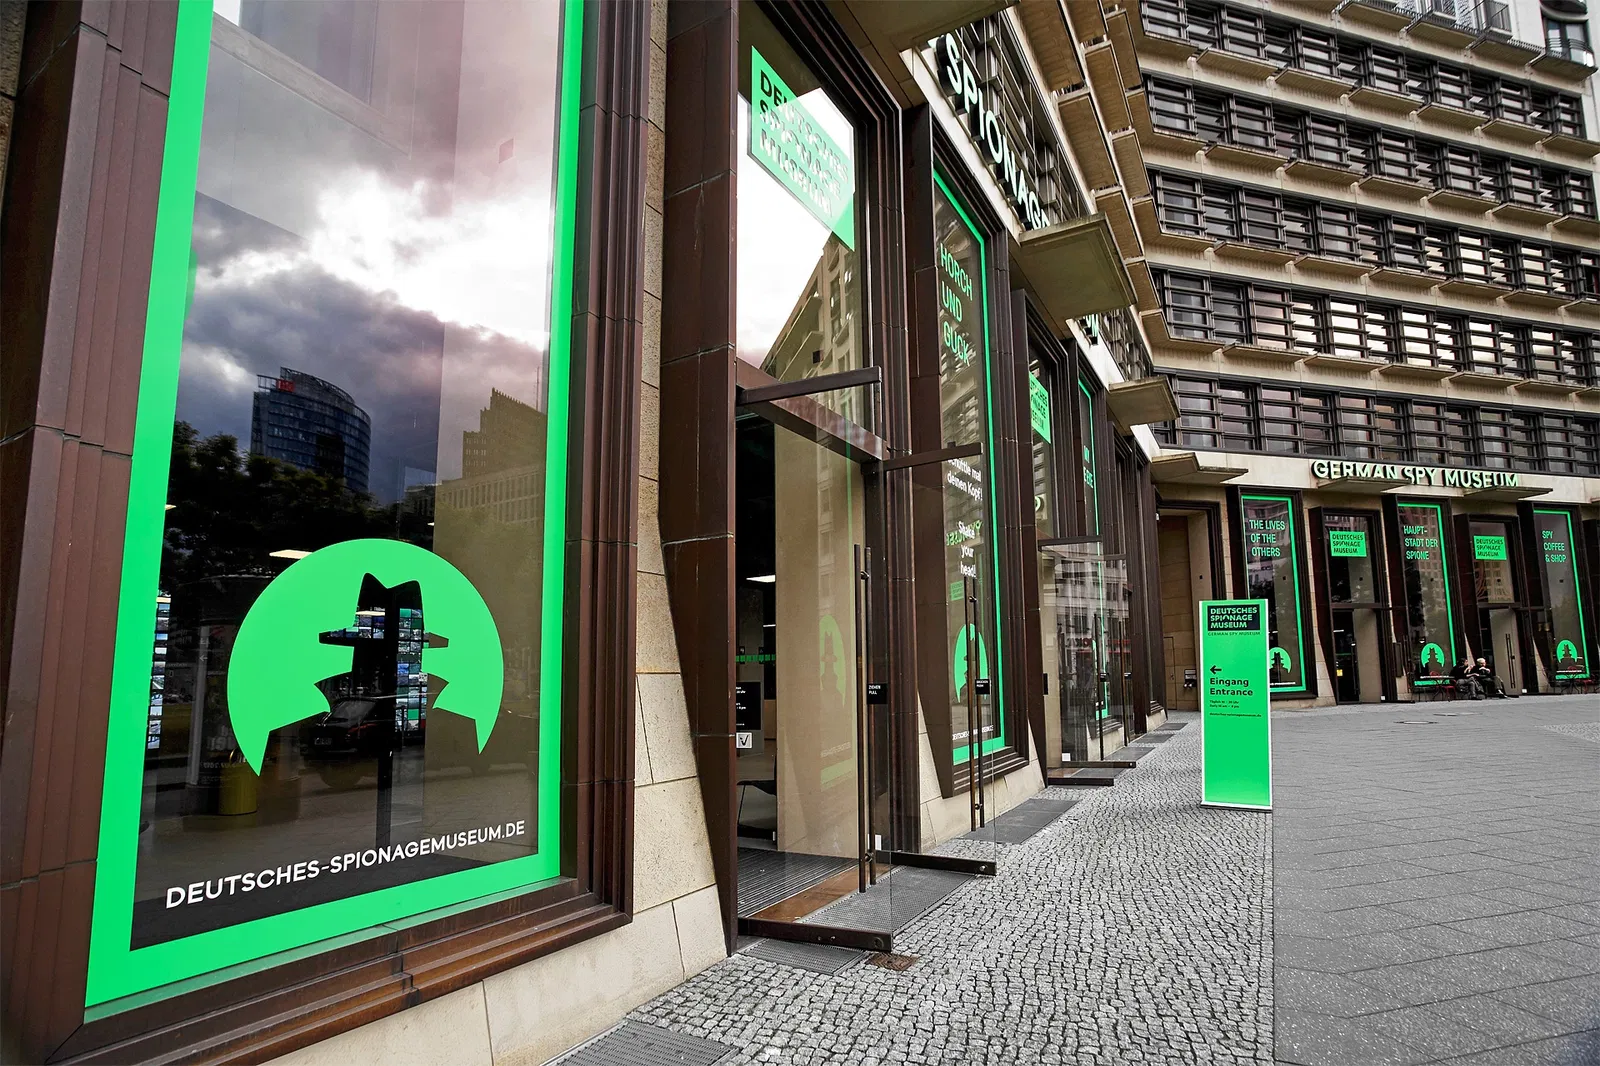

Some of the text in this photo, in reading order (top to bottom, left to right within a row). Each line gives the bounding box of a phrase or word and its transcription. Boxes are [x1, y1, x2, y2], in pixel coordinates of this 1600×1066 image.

[760, 69, 849, 184] DEUTSCHES
[759, 99, 841, 200] SPIONAGE
[759, 128, 834, 218] MUSEUM
[940, 242, 973, 301] HORCH
[941, 280, 963, 322] UND
[943, 321, 971, 367] GUCK
[1312, 460, 1518, 488] GERMAN SPY MUSEUM
[947, 470, 983, 501] deinen Kopf!
[1249, 519, 1286, 531] THE LIVES
[1403, 525, 1428, 535] HAUPT-
[1250, 533, 1276, 543] OF THE
[1331, 533, 1363, 541] DEUTSCHES
[1541, 530, 1553, 539] SPY
[1332, 540, 1360, 548] SPIONAGE
[1404, 538, 1438, 547] STADT DER
[1543, 542, 1565, 551] COFFEE
[960, 544, 975, 559] your
[1251, 547, 1280, 557] OTHERS
[1405, 550, 1429, 560] SPIONE
[1545, 554, 1567, 563] & SHOP
[1210, 606, 1257, 615] DEUTSCHES
[1210, 614, 1253, 622] SPIONAGE
[1210, 621, 1247, 629] MUSEUM
[1209, 677, 1249, 687] Eingang
[1209, 687, 1254, 696] Entrance
[165, 820, 525, 909] DEUTSCHES-SPIONAGEMUSEUM.DE
